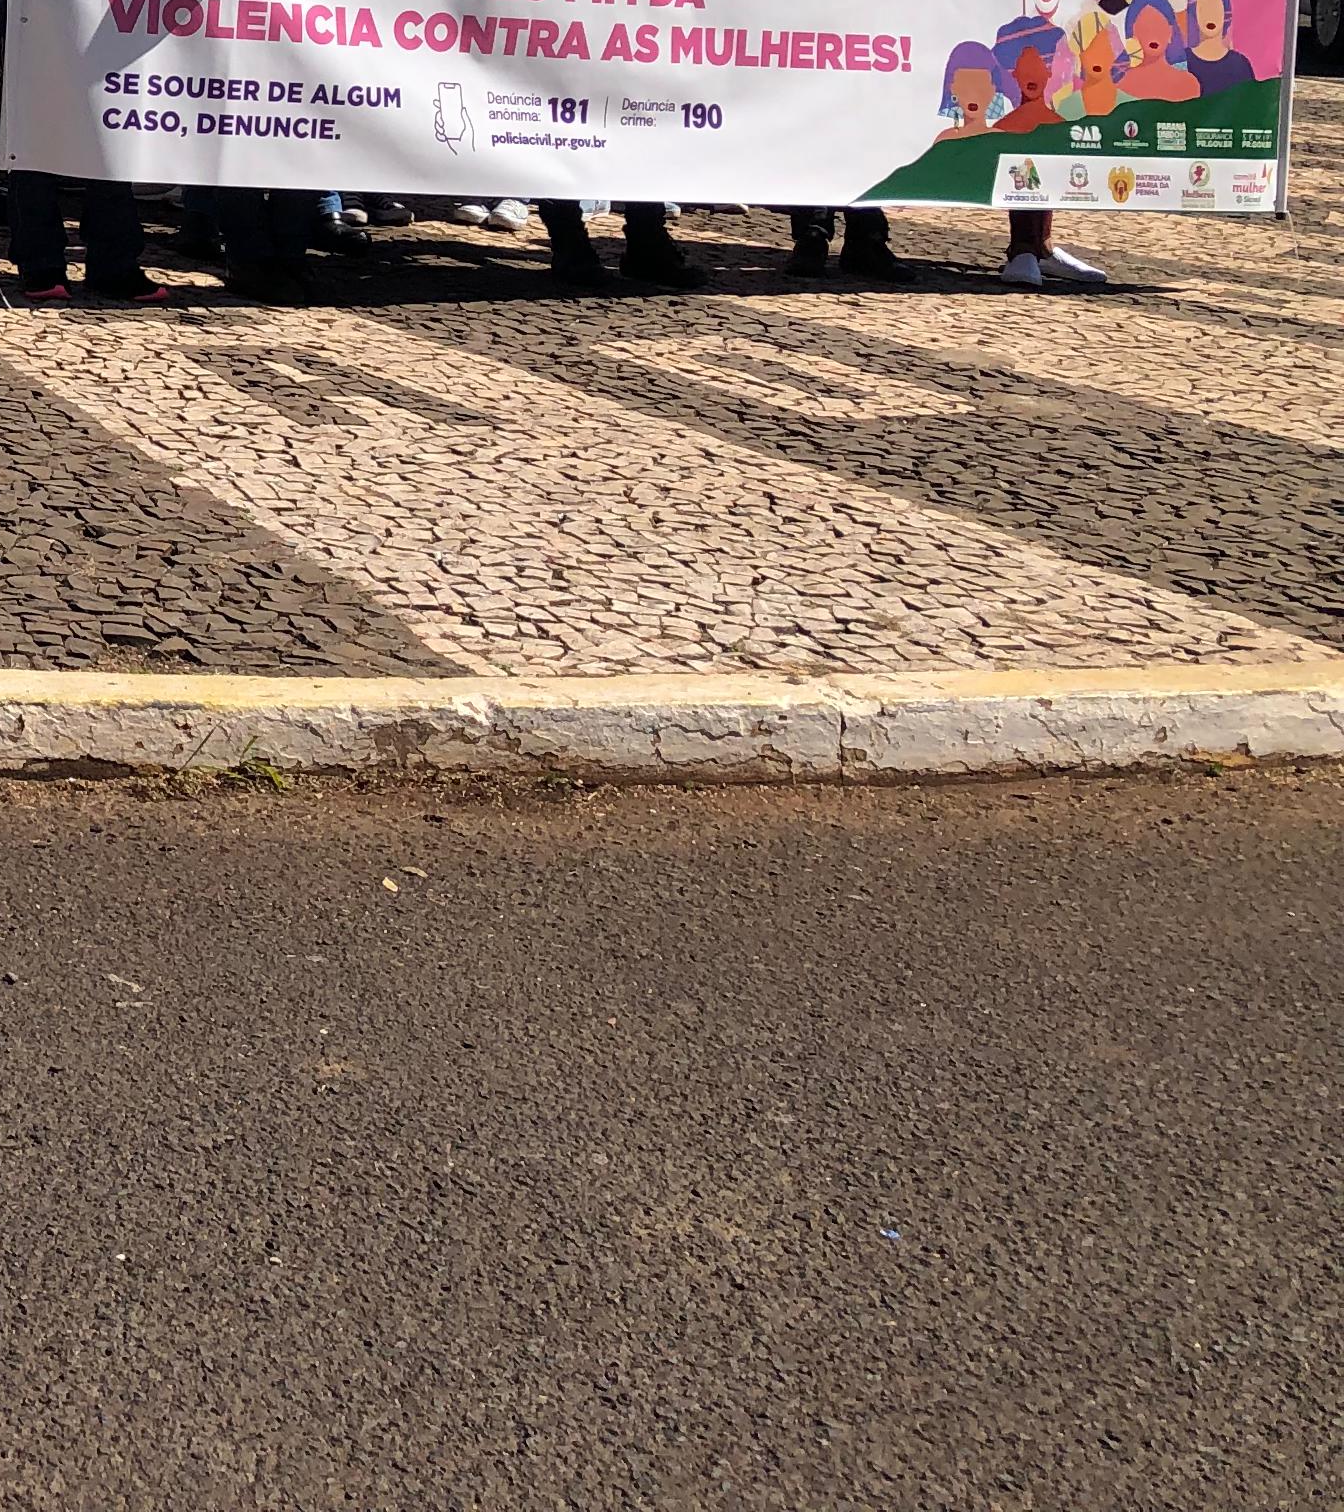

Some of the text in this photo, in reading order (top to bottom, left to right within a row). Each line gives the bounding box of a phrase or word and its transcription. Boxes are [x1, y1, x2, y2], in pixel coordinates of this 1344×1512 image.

[393, 9, 591, 61] CONTRA
[600, 22, 661, 64] AS
[670, 25, 913, 73] MULHERES!
[102, 71, 402, 109] SE SOUBER DE ALGUM
[487, 90, 542, 108] Denúncia
[487, 106, 542, 123] anônima:
[547, 96, 590, 125] 181
[621, 97, 676, 114] Denúncia
[102, 108, 342, 141] CASO, DENUNCIE.
[619, 113, 657, 128] crime:
[680, 102, 724, 130] 190
[491, 131, 607, 151] policiacivil.pr.gov.br
[1135, 181, 1159, 189] MARIA
[1135, 189, 1160, 197] PENHA
